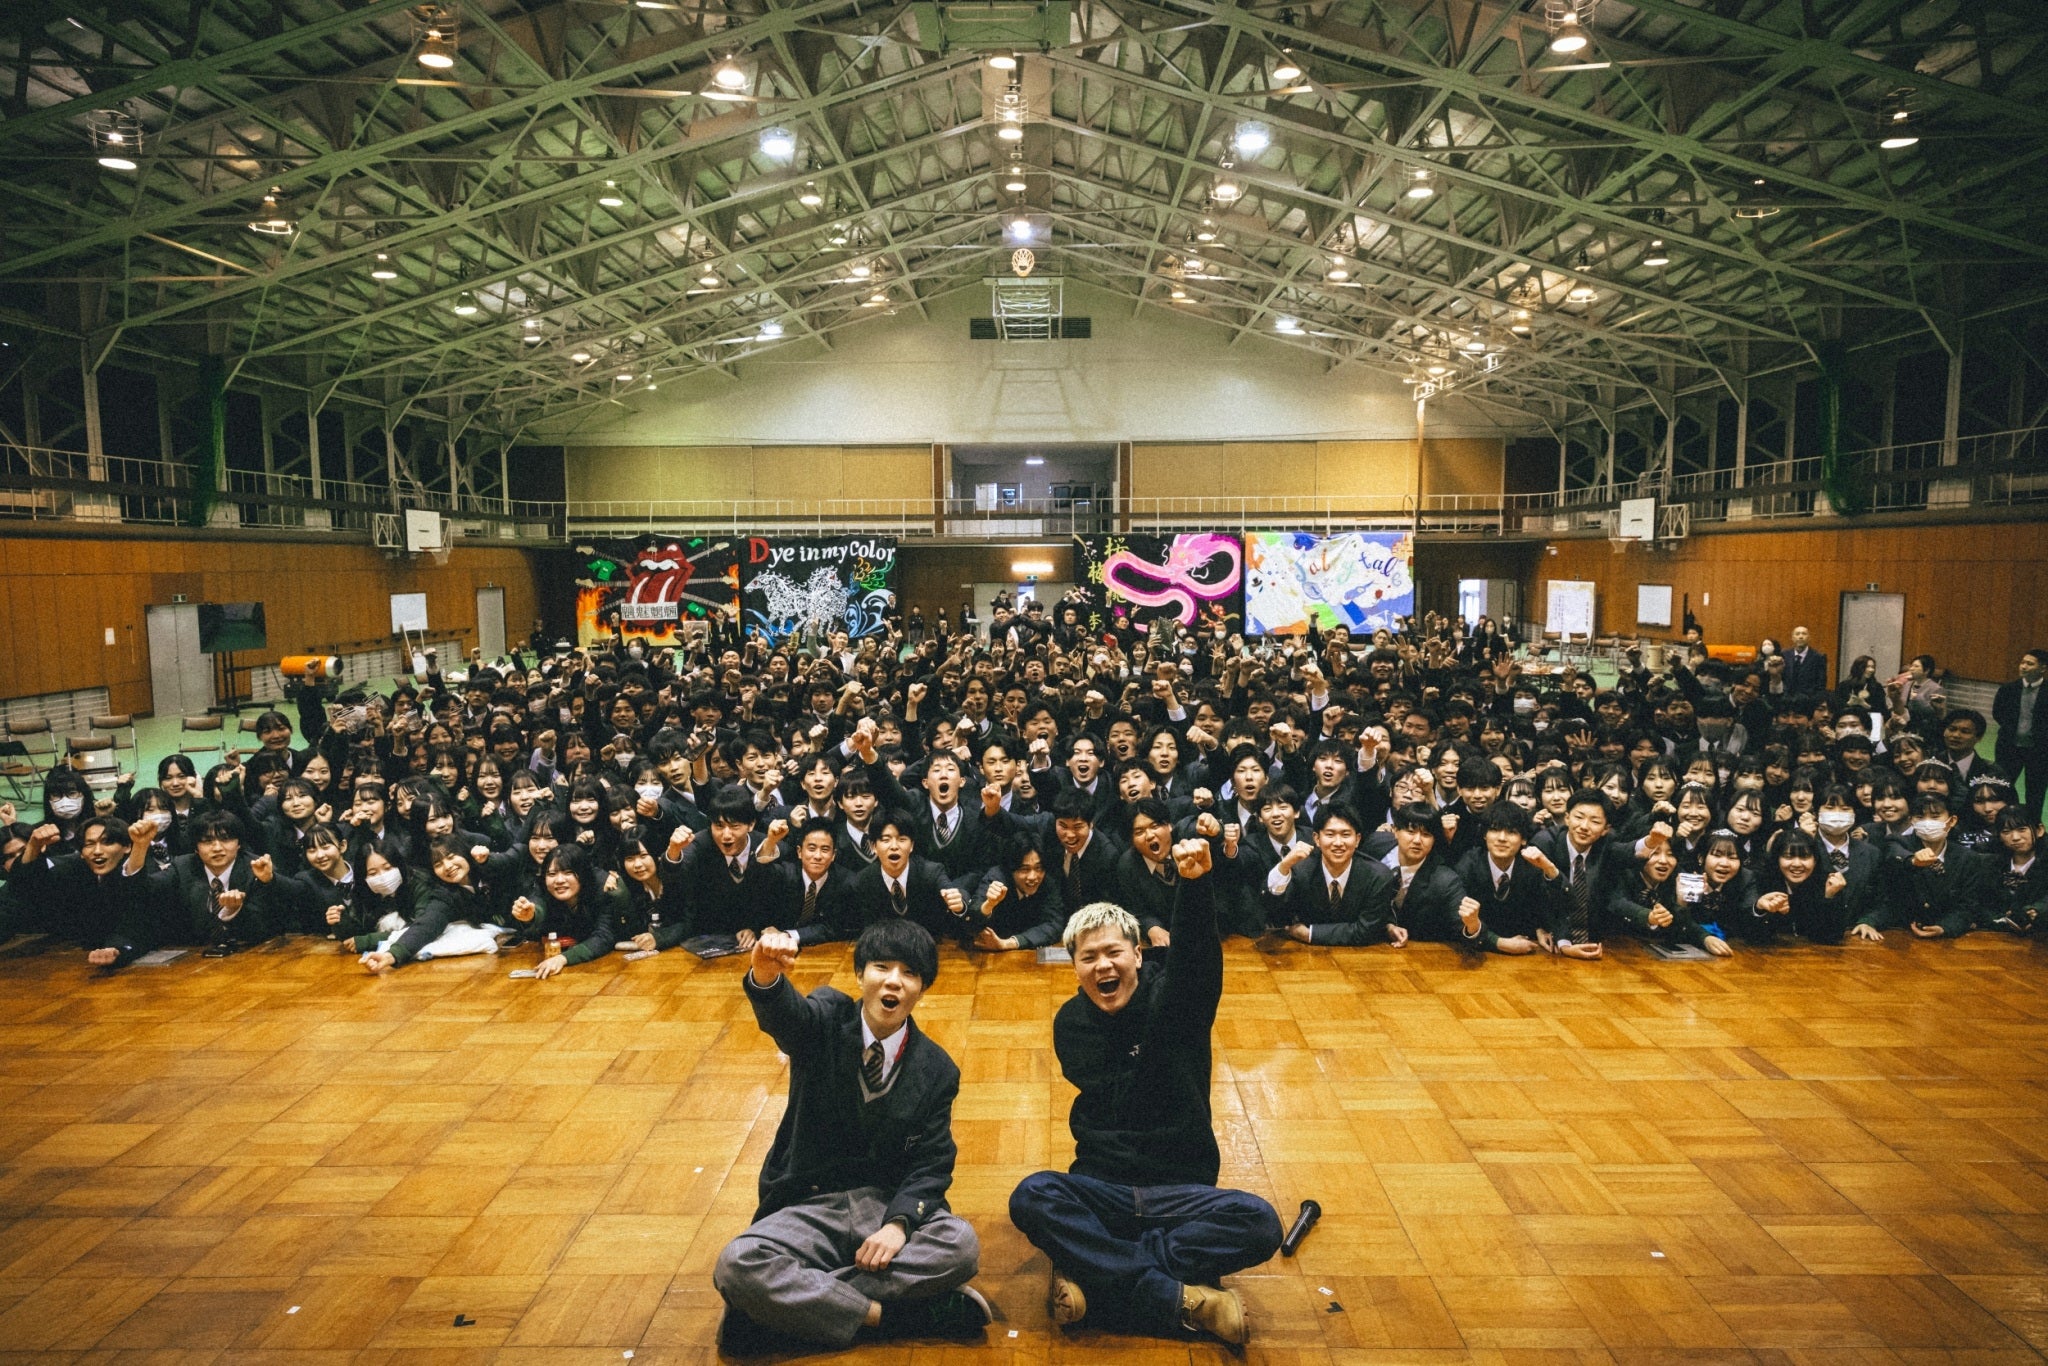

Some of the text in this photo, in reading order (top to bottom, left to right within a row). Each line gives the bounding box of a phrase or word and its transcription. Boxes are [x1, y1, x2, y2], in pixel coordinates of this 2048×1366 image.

[749, 537, 795, 568] Dye
[799, 545, 821, 562] in
[821, 545, 848, 564] my
[1358, 551, 1402, 587] tale
